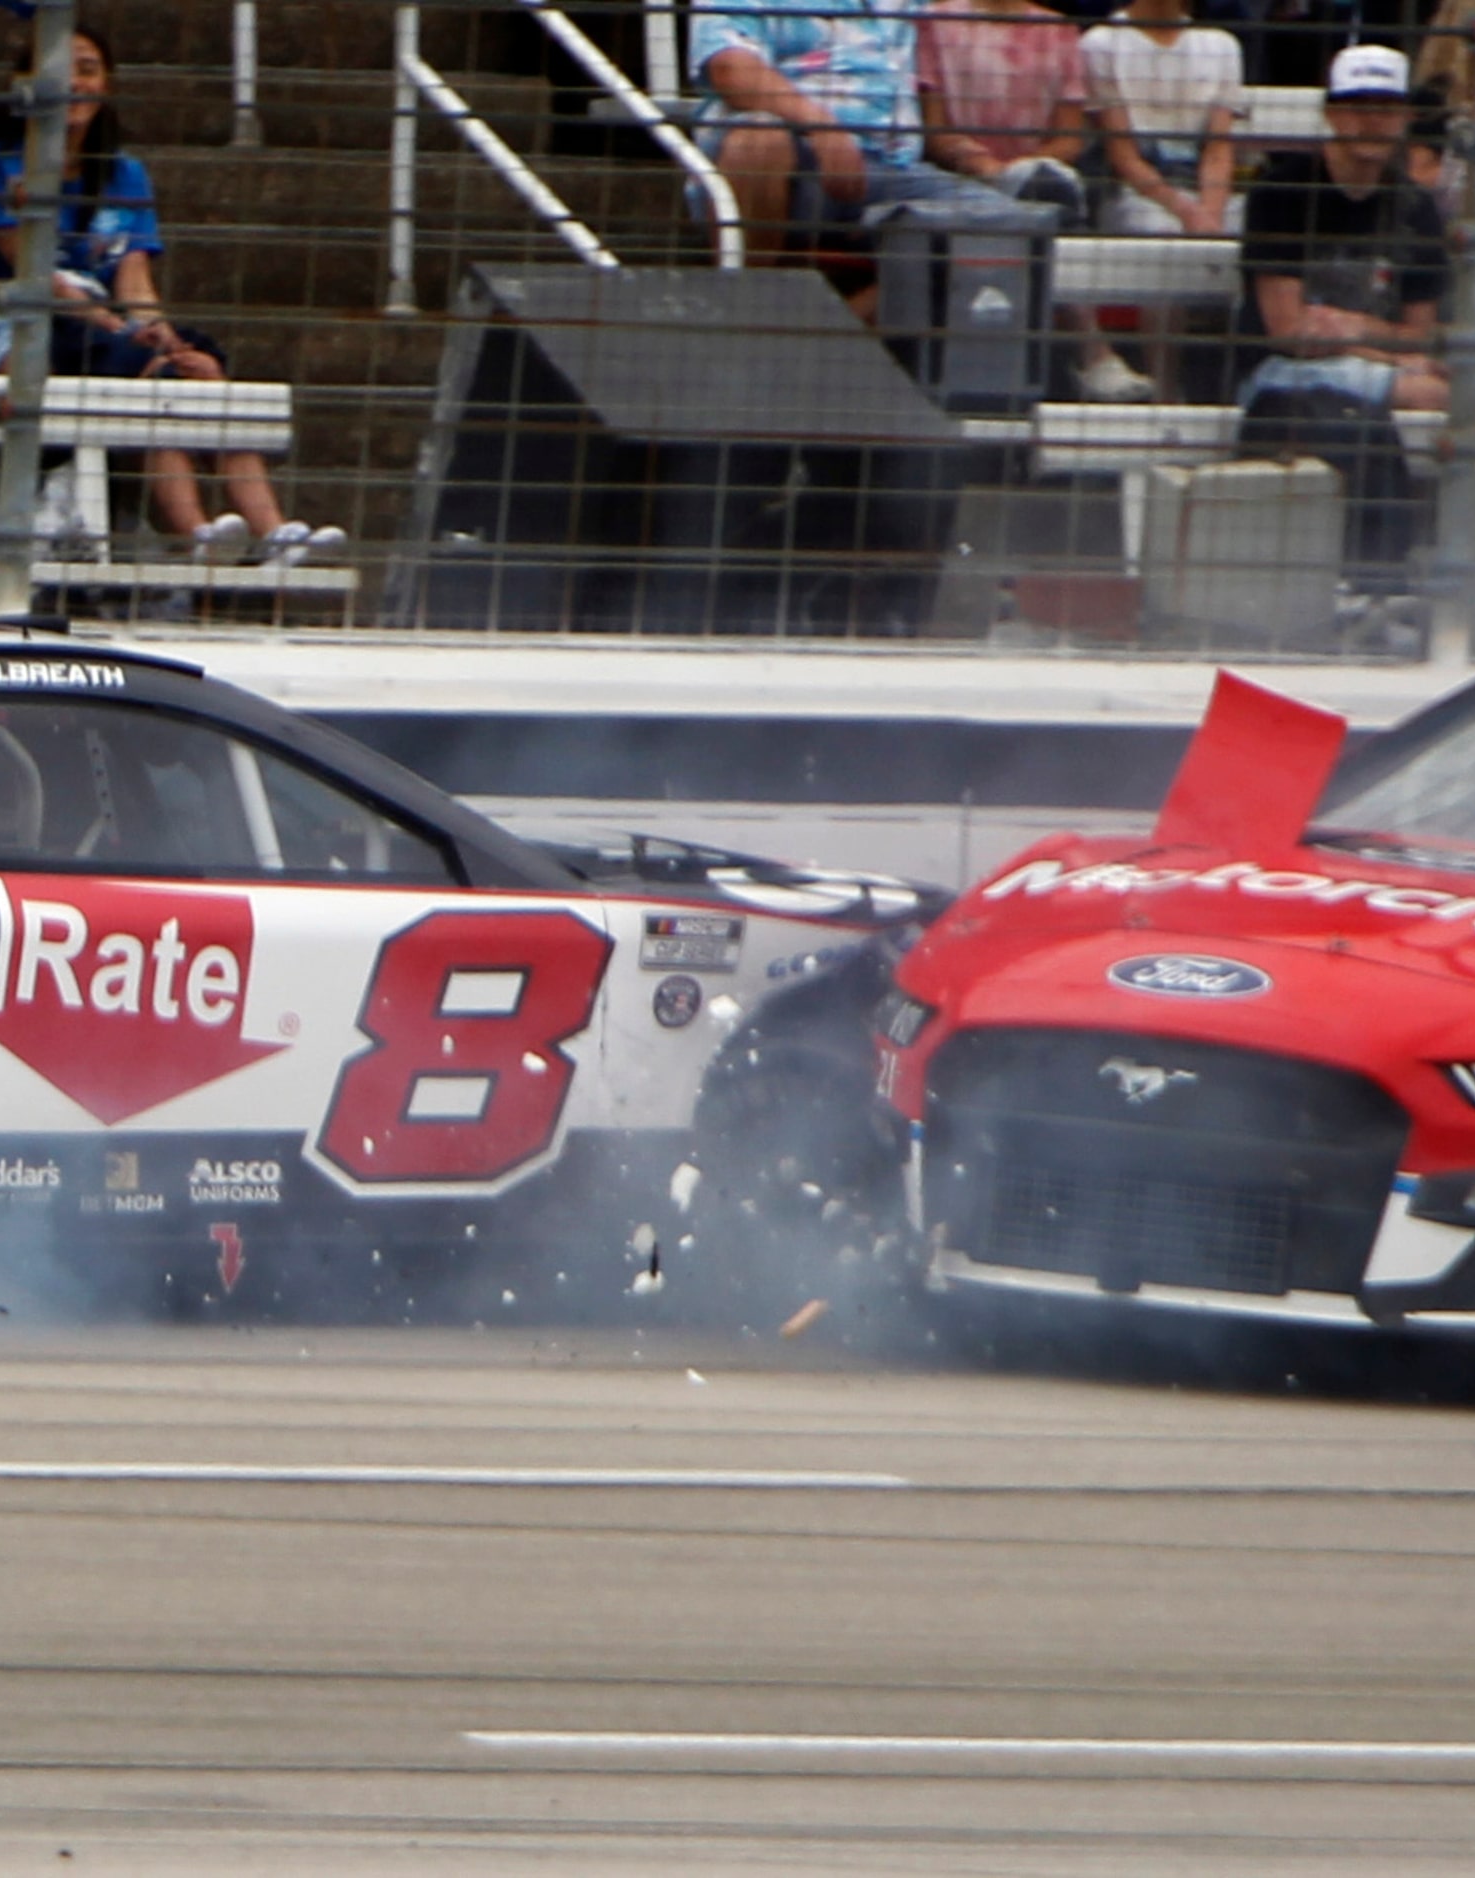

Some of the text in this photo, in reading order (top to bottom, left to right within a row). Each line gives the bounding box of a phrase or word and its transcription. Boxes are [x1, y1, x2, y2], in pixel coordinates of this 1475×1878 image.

[16, 898, 243, 1027] Rate
[1132, 957, 1242, 993] Ford
[304, 905, 616, 1197] 8
[189, 1184, 281, 1203] UNIFORMS
